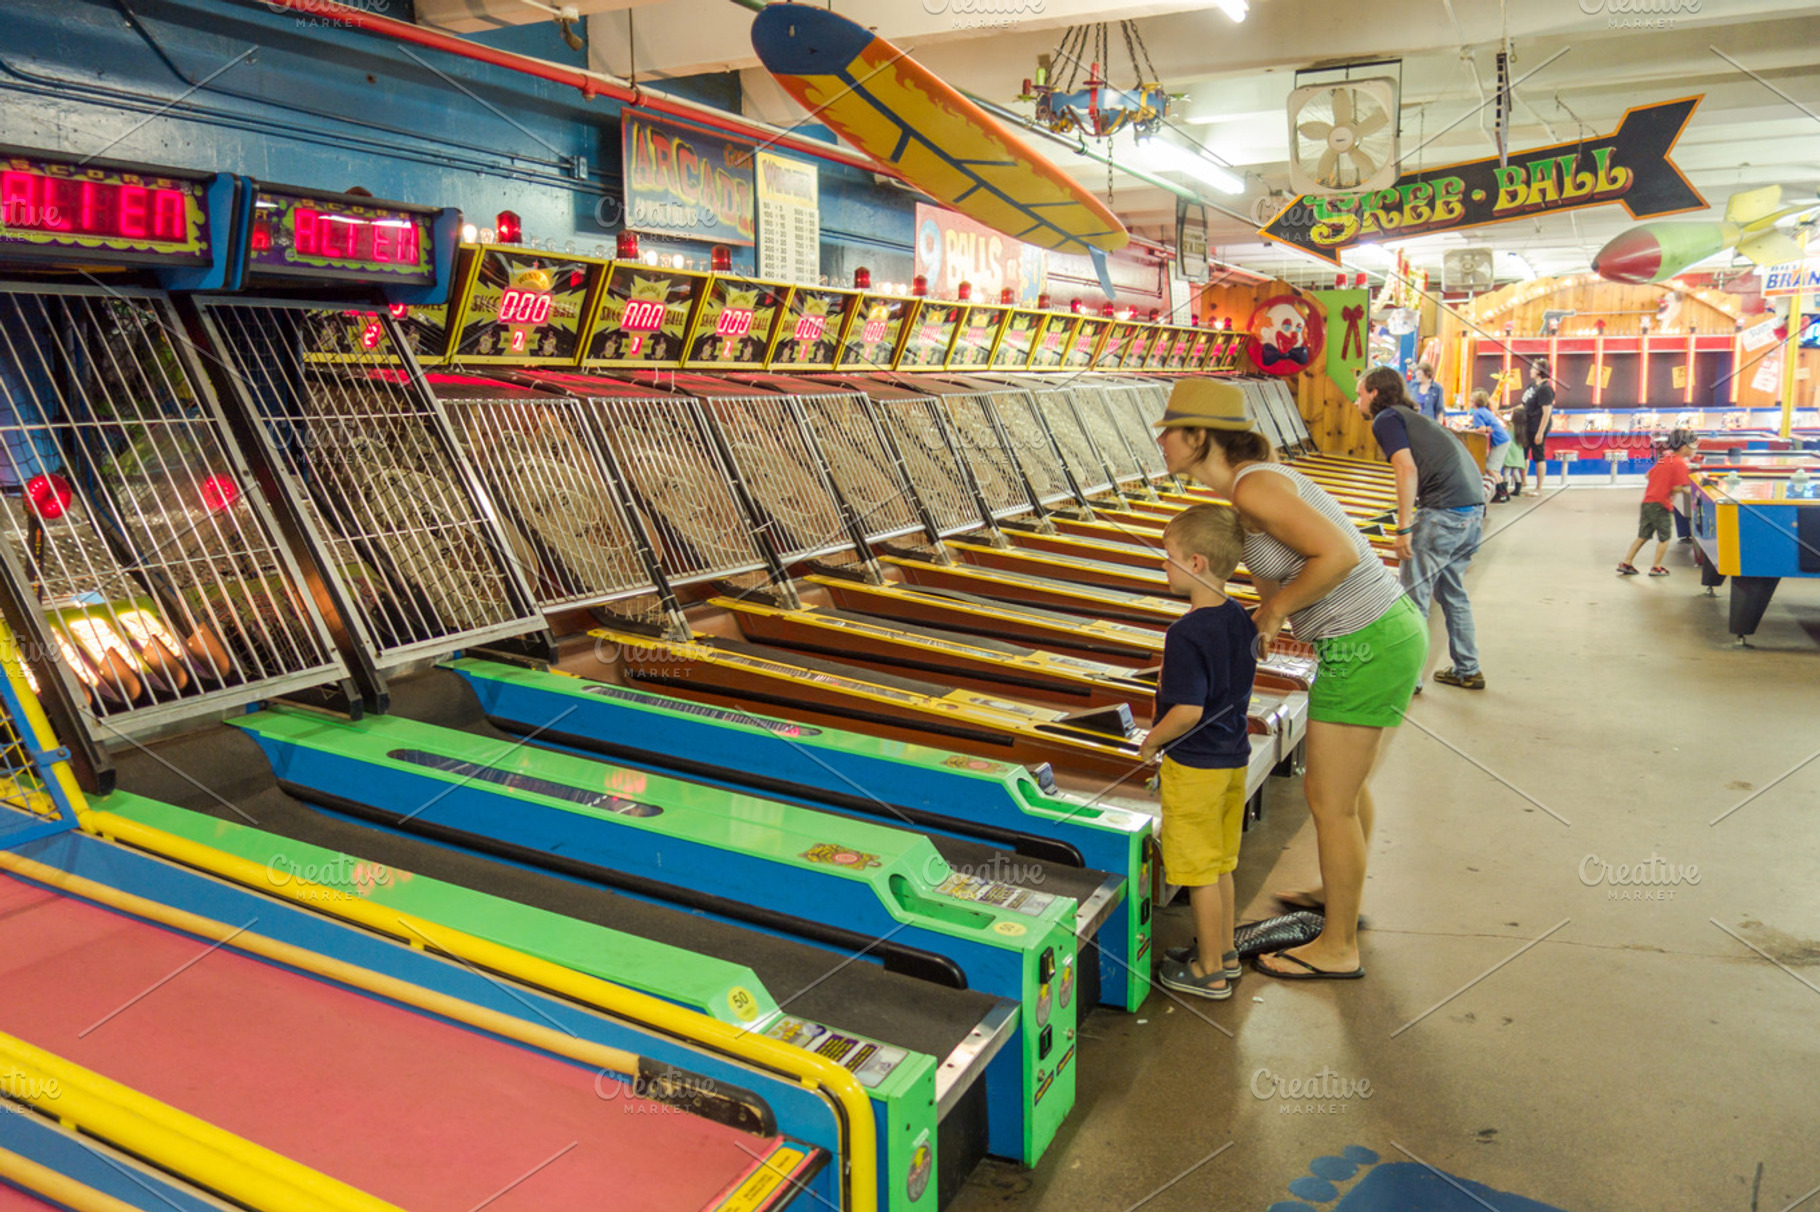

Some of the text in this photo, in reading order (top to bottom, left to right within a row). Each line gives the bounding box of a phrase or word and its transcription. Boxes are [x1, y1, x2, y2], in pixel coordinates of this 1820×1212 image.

[9, 158, 172, 188] SCORE
[1303, 147, 1634, 248] SKEE BALL
[919, 219, 1004, 296] 9 BALLS
[500, 290, 552, 323] 000
[732, 991, 749, 1009] 50
